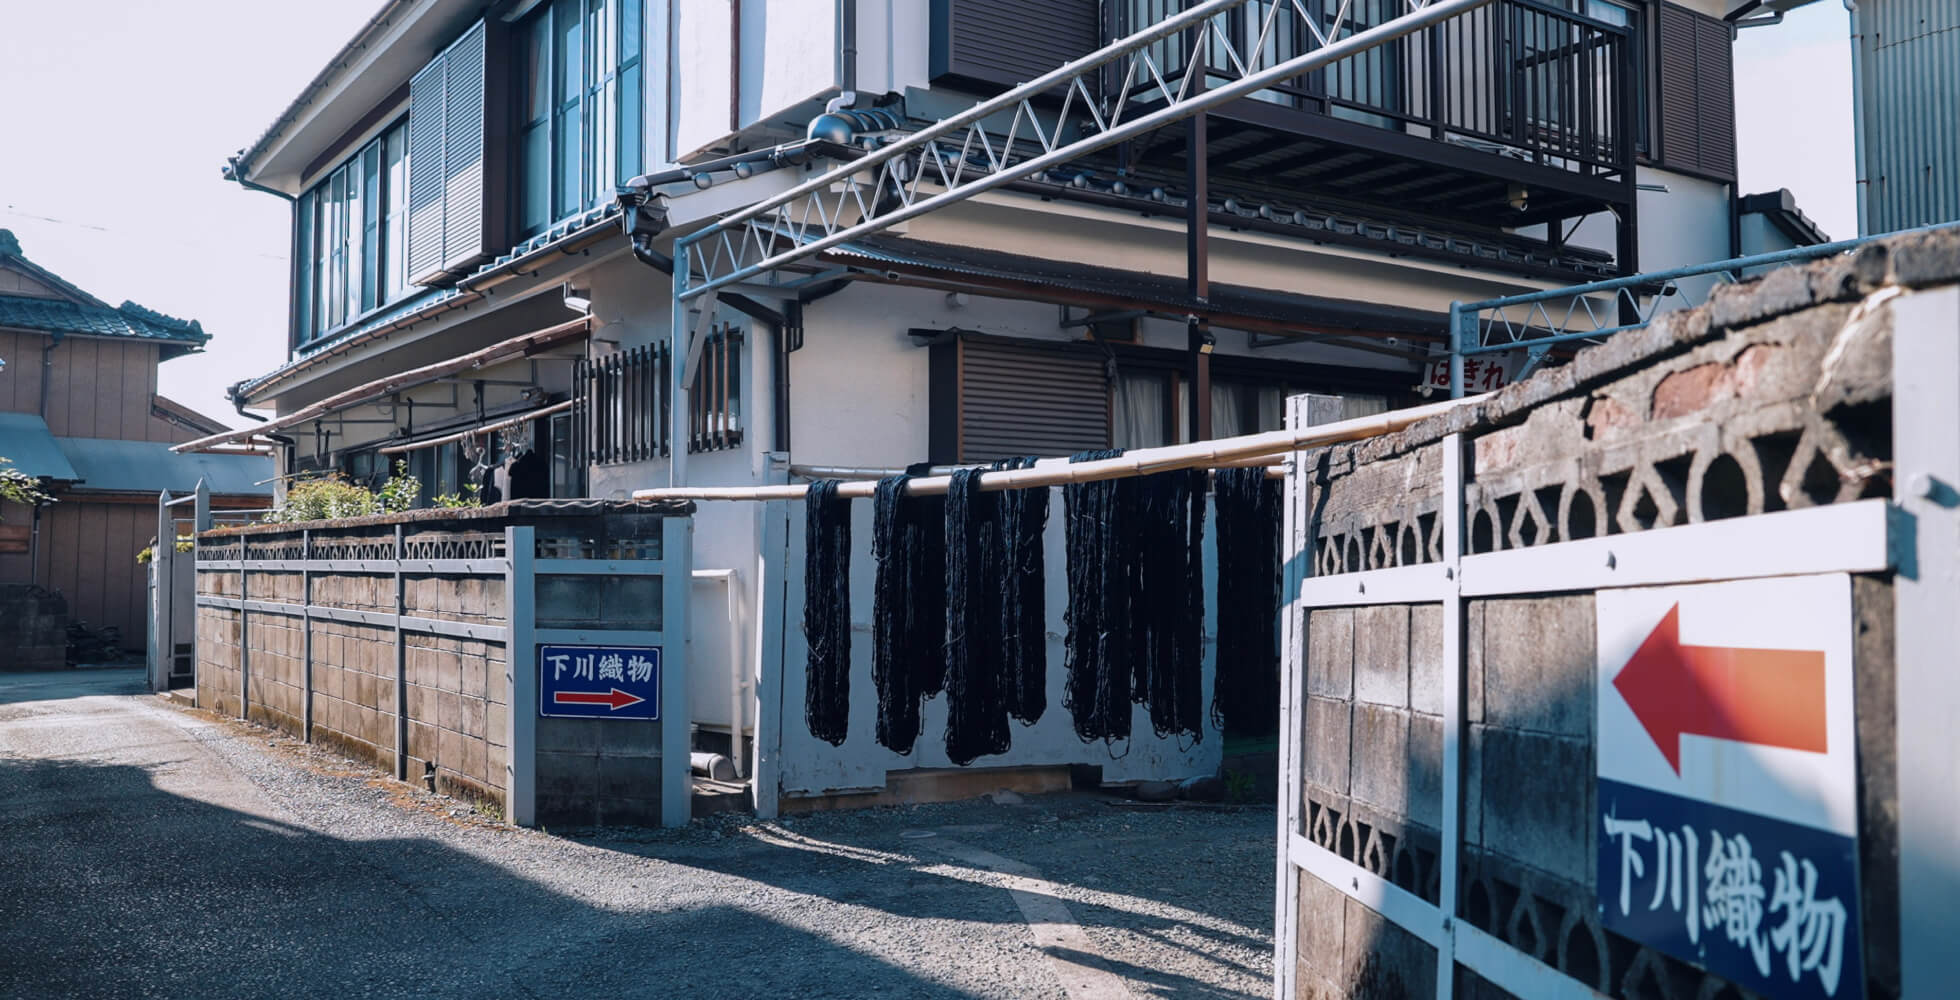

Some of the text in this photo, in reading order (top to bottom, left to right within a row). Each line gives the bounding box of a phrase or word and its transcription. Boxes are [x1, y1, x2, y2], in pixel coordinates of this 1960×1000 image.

[1430, 358, 1504, 391] はぎれ
[546, 653, 653, 682] 下川織物
[1604, 813, 1847, 997] 下川織物
